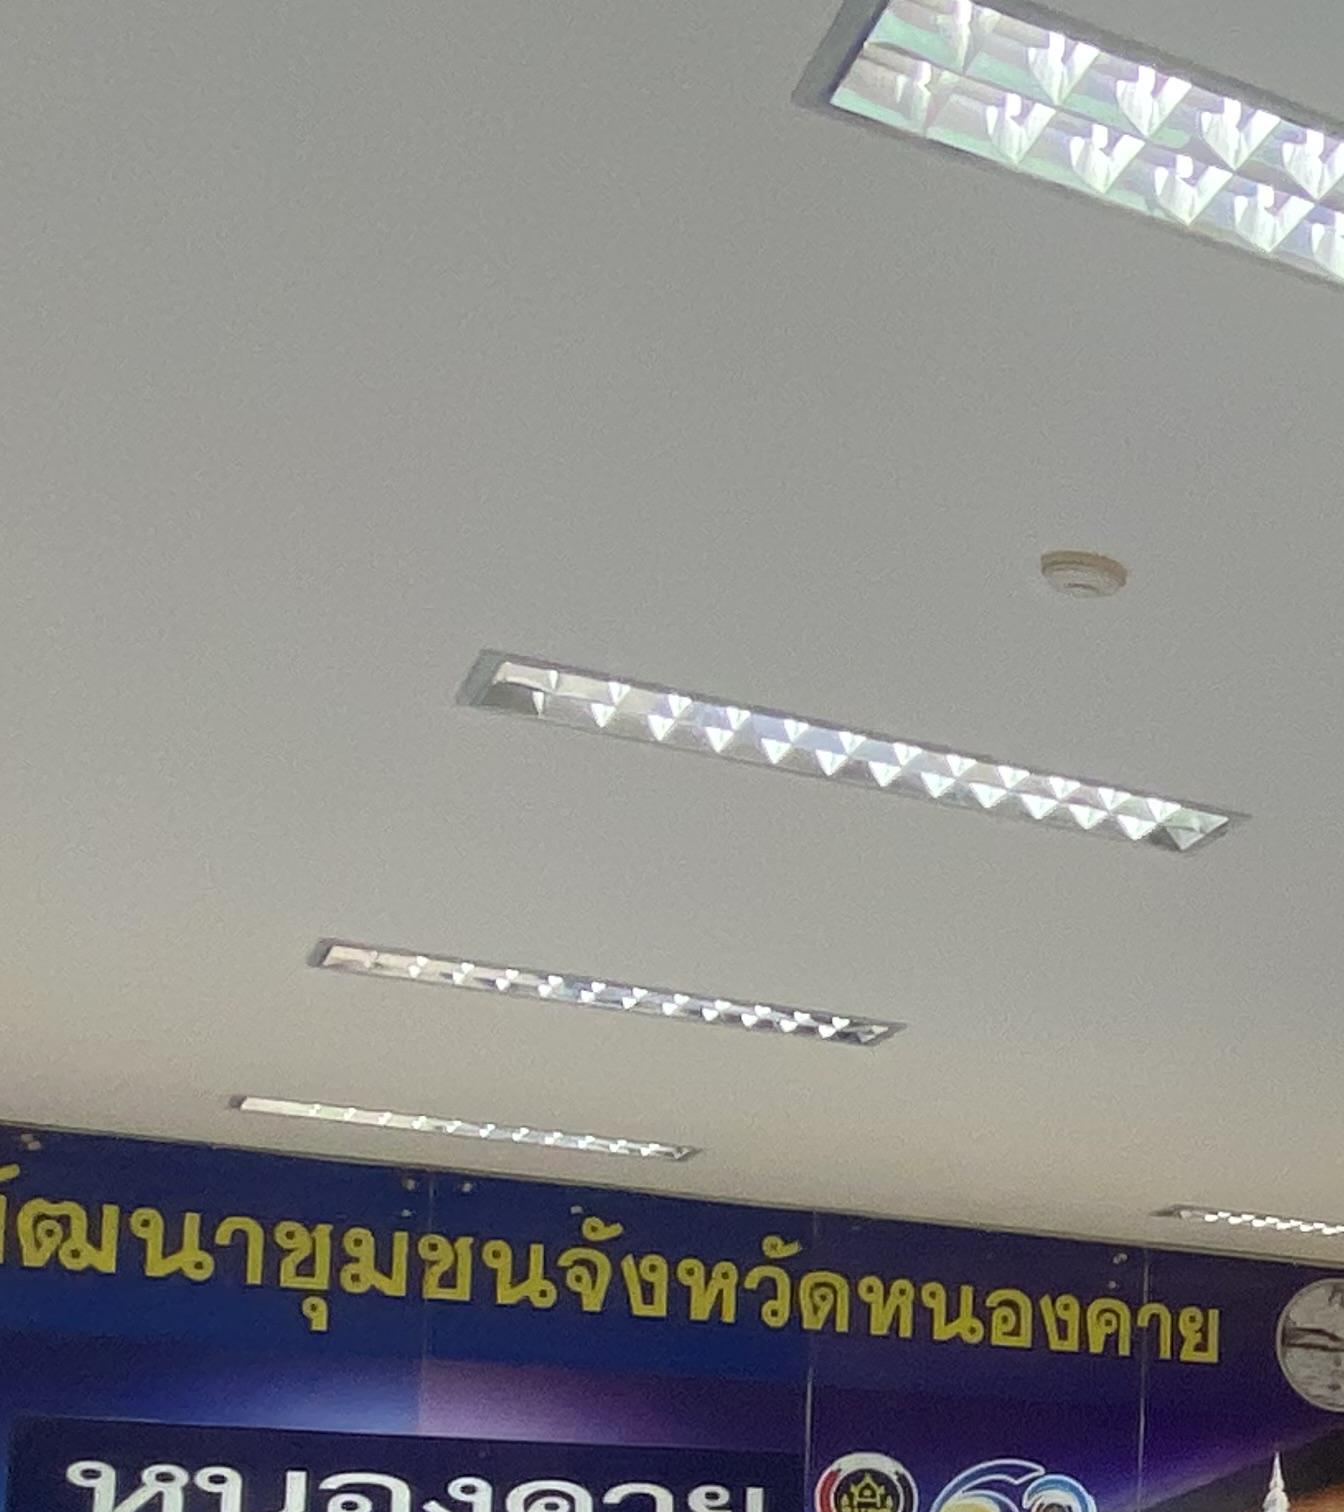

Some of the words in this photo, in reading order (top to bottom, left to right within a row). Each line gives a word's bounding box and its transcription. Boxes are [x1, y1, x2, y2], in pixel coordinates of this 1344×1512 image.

[0, 1163, 1220, 1364] ฒนาชุมชนจังหวัดหนองคาย
